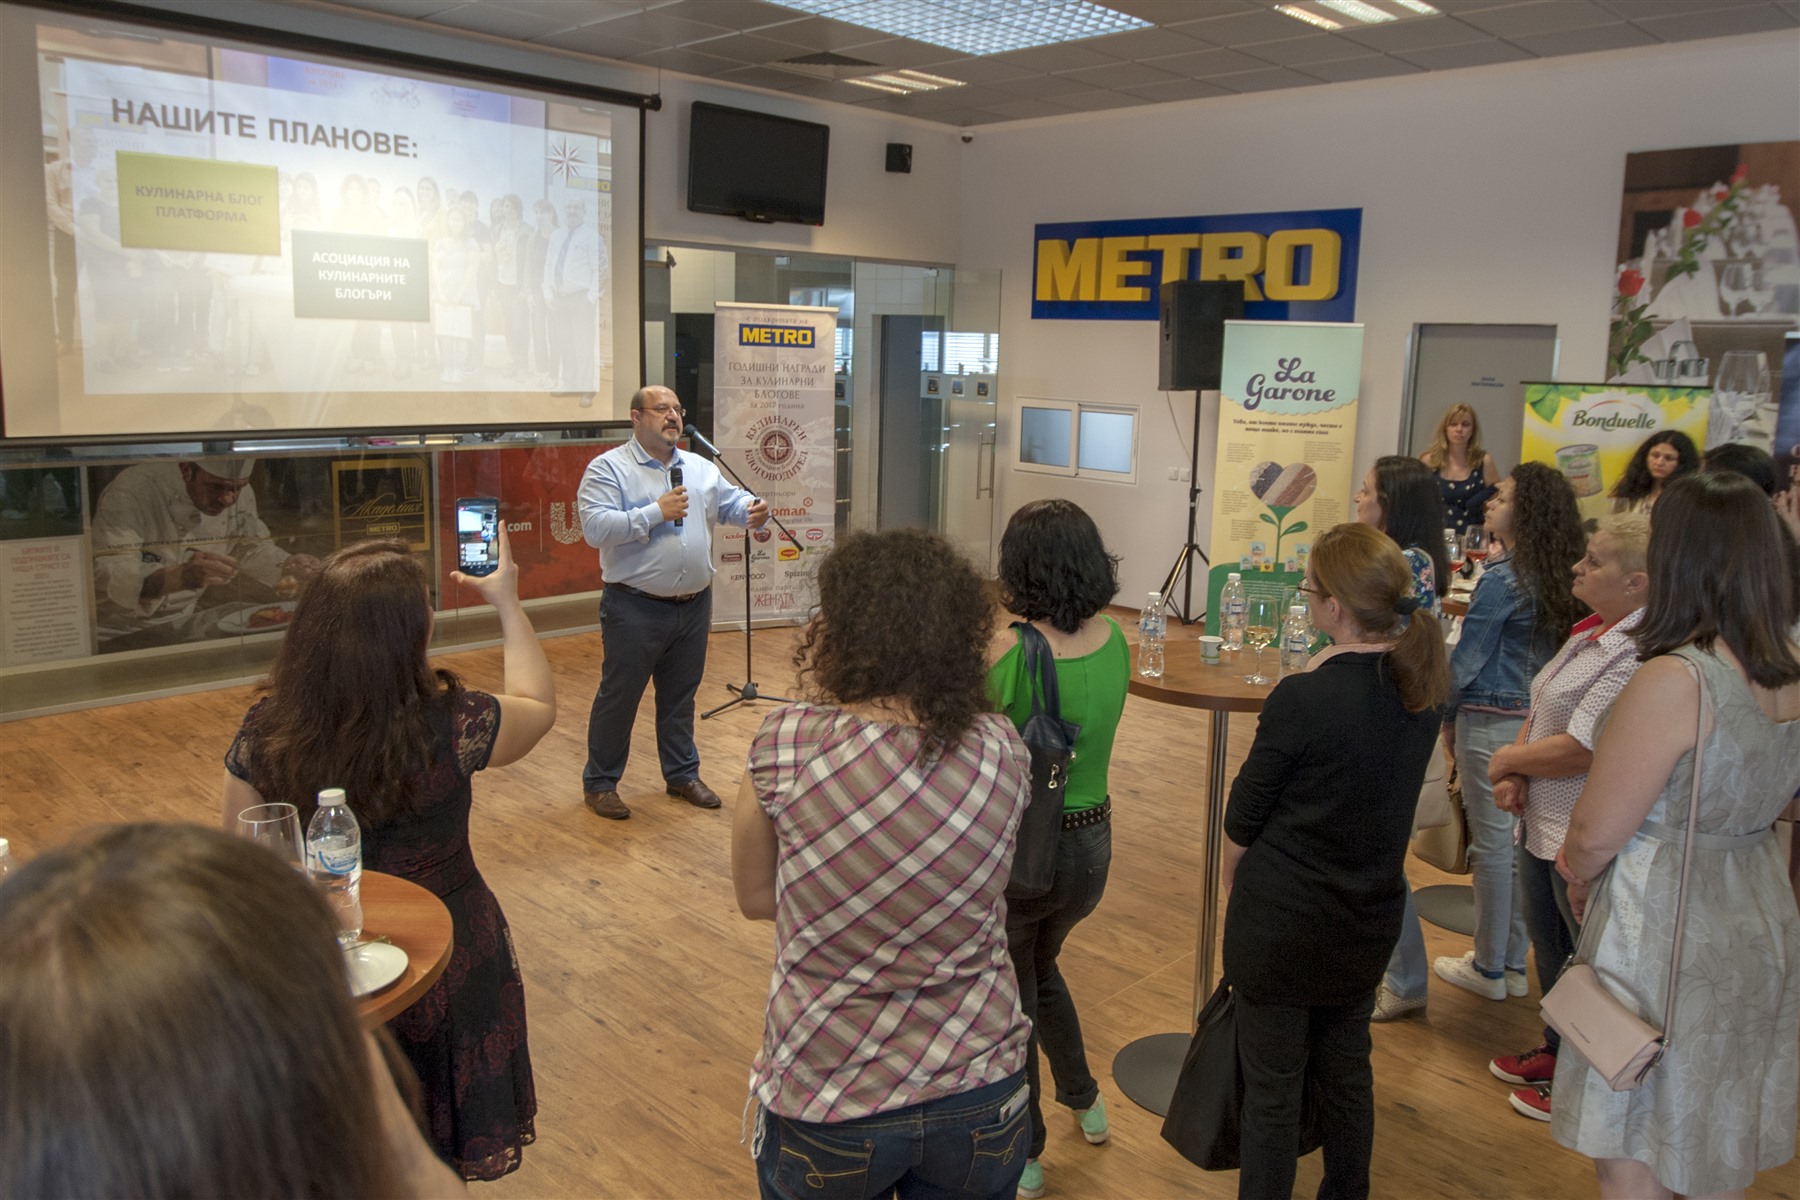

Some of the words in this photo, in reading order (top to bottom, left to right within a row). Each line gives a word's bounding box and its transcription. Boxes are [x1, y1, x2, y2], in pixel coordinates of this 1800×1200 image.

[112, 98, 257, 138] НАШИТЕ
[268, 118, 418, 158] ПЛАНОВЕ:
[135, 185, 224, 203] КУЛИНАРНА
[228, 193, 263, 206] БЛОГ
[155, 206, 248, 223] ПЛАТФОРМА
[312, 251, 390, 268] АСОЦИАЦИЯ
[394, 257, 411, 268] НА
[1035, 228, 1342, 302] METRO
[318, 269, 407, 285] КУЛИНАРНИТЕ
[335, 287, 392, 301] БЛОГЪРИ
[742, 327, 812, 345] METRO
[728, 362, 779, 372] ГОДИШНИ
[782, 363, 826, 374] НАГРАДИ
[1274, 357, 1316, 383] La
[741, 376, 753, 386] ЗА
[756, 377, 814, 387] КУЛИНАРНИ
[754, 391, 800, 400] БЛОГОВЕ
[1243, 373, 1336, 411] Garone
[745, 415, 807, 441] КУЛИНАРЕН
[1572, 410, 1657, 432] Bonduelle
[745, 449, 808, 481] БЛОГОВОДИТЕЛ
[369, 525, 397, 533] METRO
[730, 573, 765, 581] KENOOD
